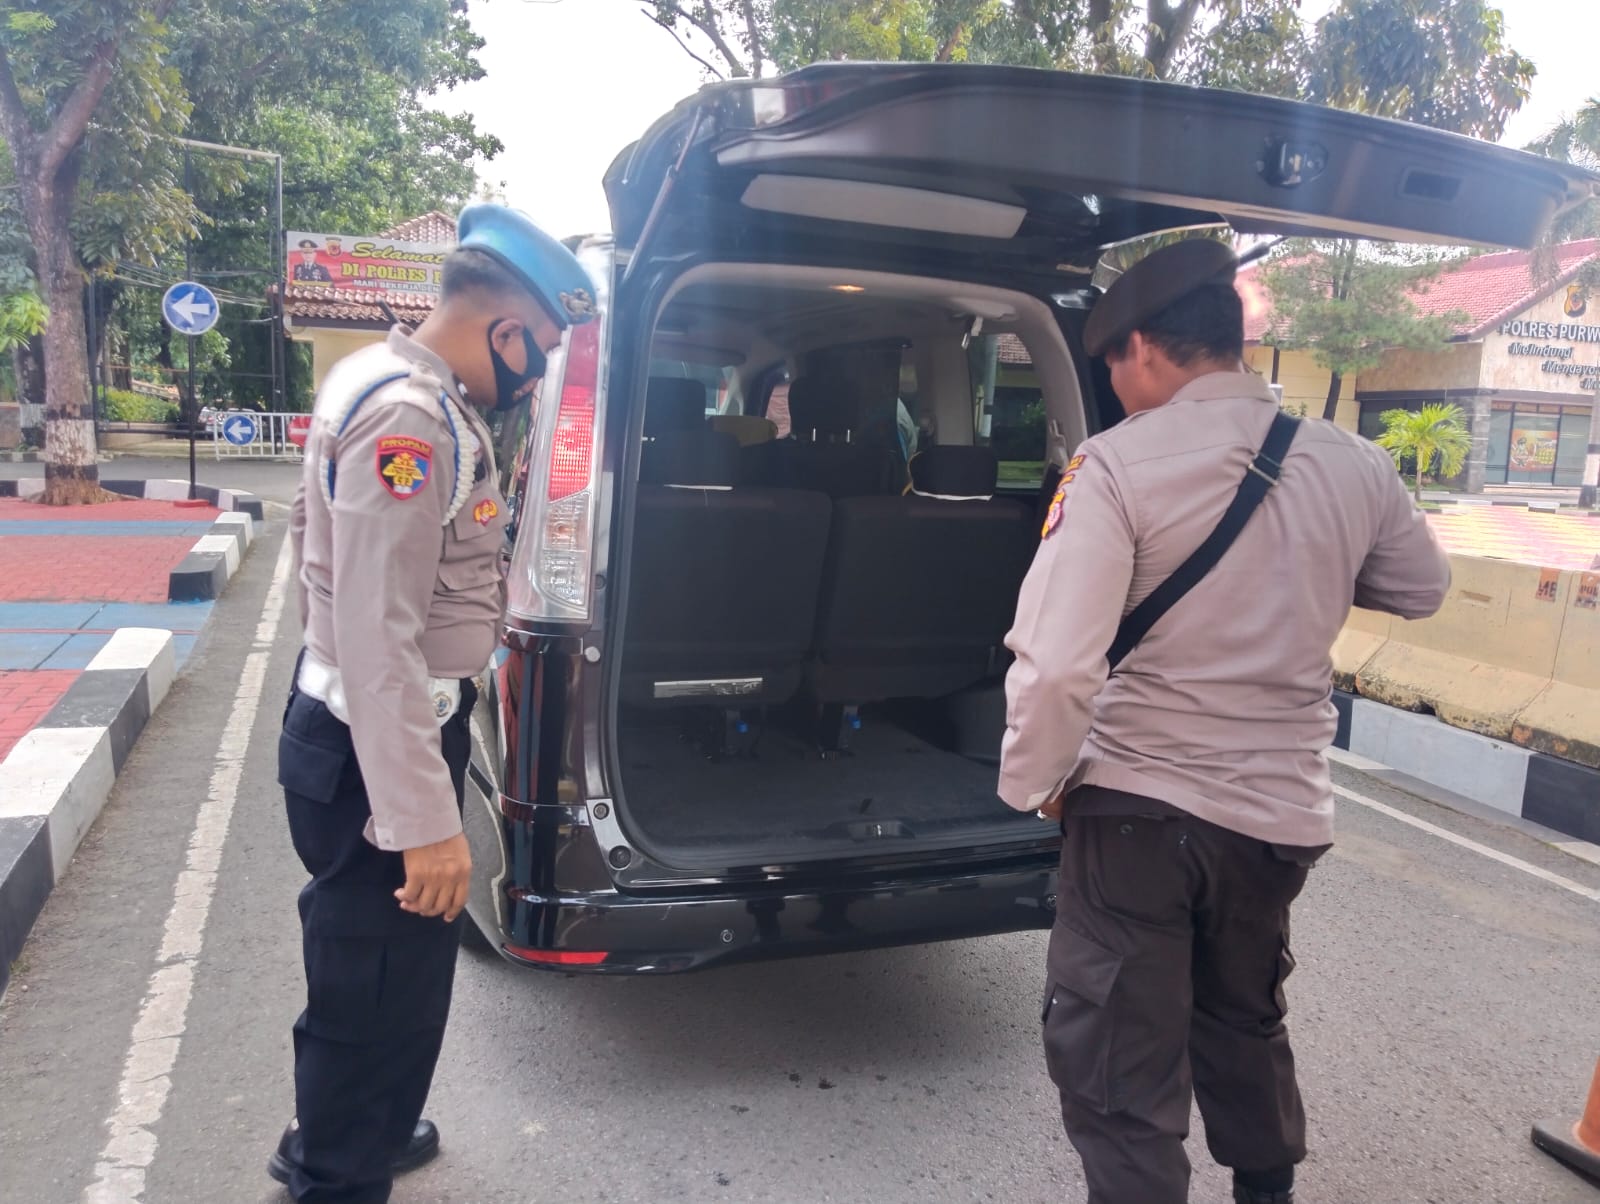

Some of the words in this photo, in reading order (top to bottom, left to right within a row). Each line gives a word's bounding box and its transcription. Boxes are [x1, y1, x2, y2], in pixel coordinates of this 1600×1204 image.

[352, 242, 444, 263] Selamat
[342, 263, 360, 277] DI
[366, 264, 427, 281] POLRES
[353, 279, 377, 288] MARI
[1501, 321, 1555, 339] POLRES
[382, 439, 430, 452] PROPAM
